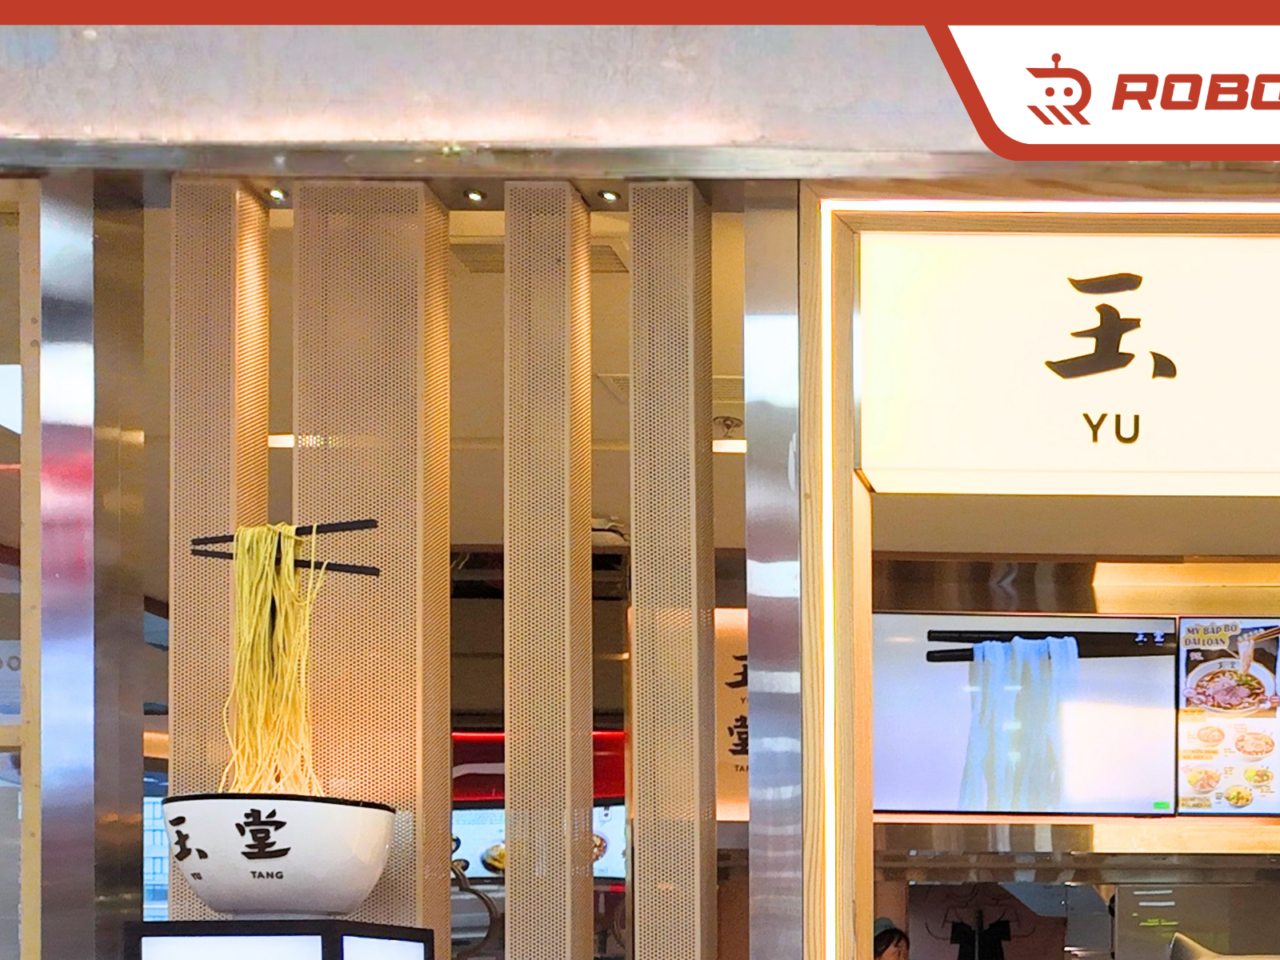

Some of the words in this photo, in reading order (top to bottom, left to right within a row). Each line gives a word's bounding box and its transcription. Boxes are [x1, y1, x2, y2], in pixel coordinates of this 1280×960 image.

[1044, 273, 1177, 379] 玉
[1083, 413, 1139, 444] YU
[235, 809, 291, 860] 堂
[251, 871, 283, 879] TANG
